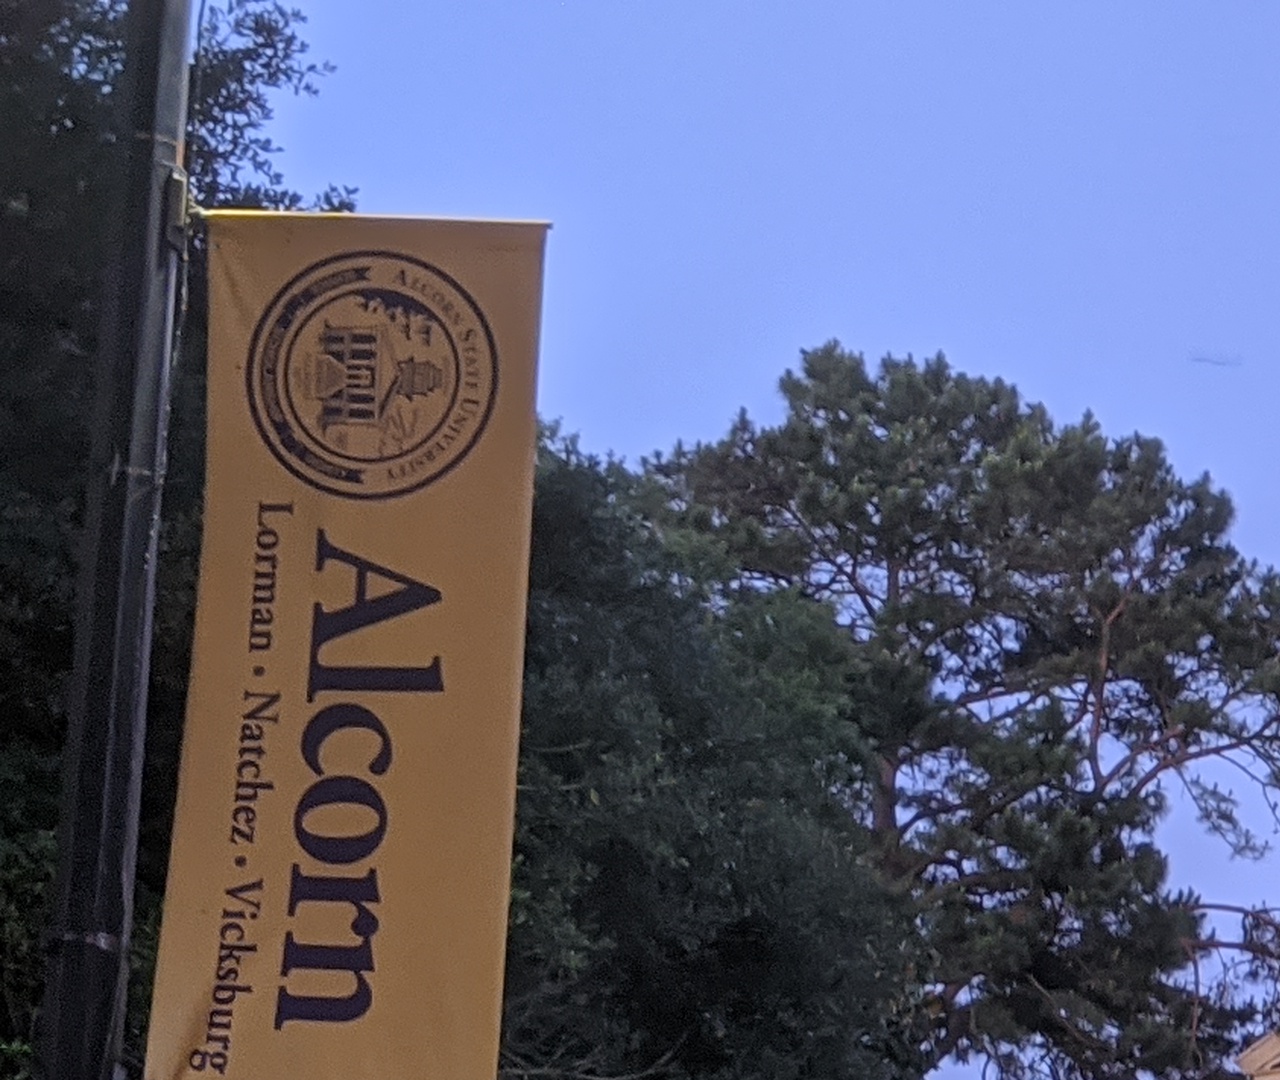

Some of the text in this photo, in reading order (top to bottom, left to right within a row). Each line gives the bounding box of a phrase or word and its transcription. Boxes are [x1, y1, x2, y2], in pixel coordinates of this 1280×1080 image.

[387, 269, 480, 480] ALCORN STATE UNIVERSITY
[189, 501, 294, 1076] Lorman Natchez Vicksburg
[270, 528, 444, 1032] Alcorn
